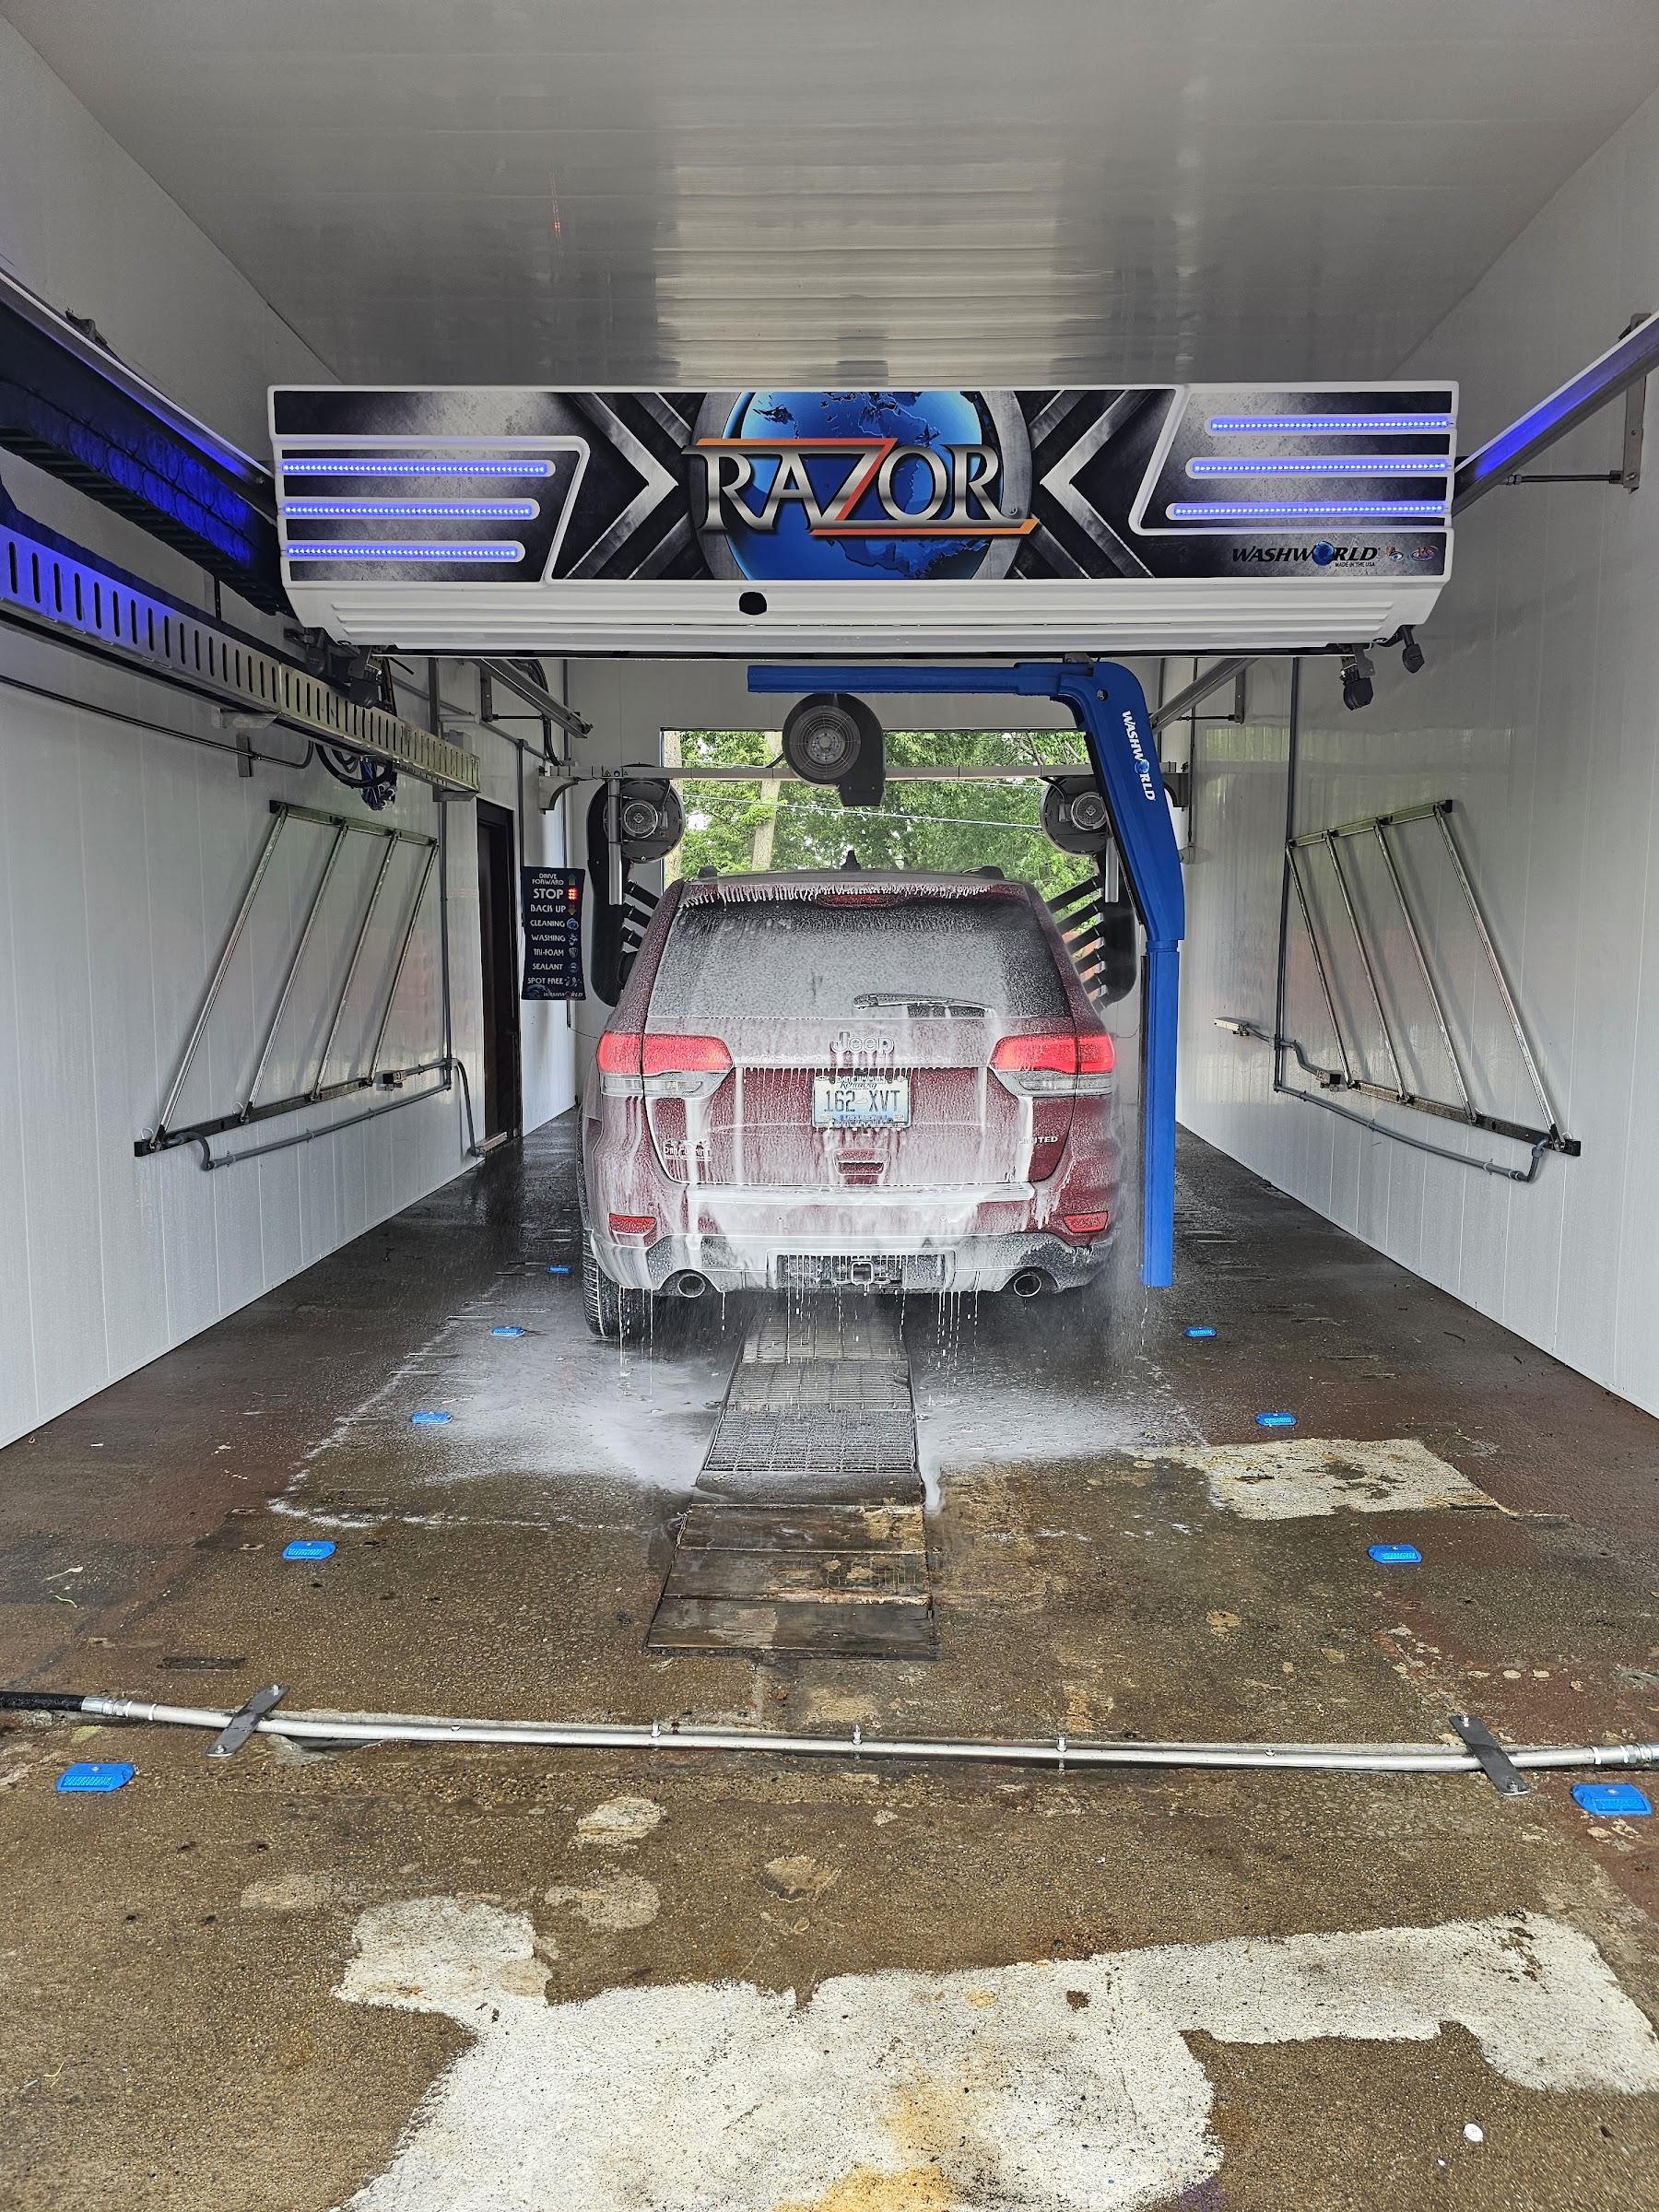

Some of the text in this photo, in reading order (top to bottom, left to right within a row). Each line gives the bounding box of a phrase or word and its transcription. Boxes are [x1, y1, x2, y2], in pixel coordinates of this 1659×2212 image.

[681, 438, 1040, 535] RAZOR
[1232, 541, 1378, 566] WASHWORLD
[1122, 711, 1156, 801] WASHWORLD
[533, 888, 564, 900] STOP
[530, 903, 553, 912] BACK
[530, 919, 565, 927] CLEANING
[531, 934, 566, 942] WASHING
[830, 1031, 894, 1058] Jeep
[824, 1089, 900, 1112] 162 XVT
[1015, 1135, 1058, 1144] ITED
